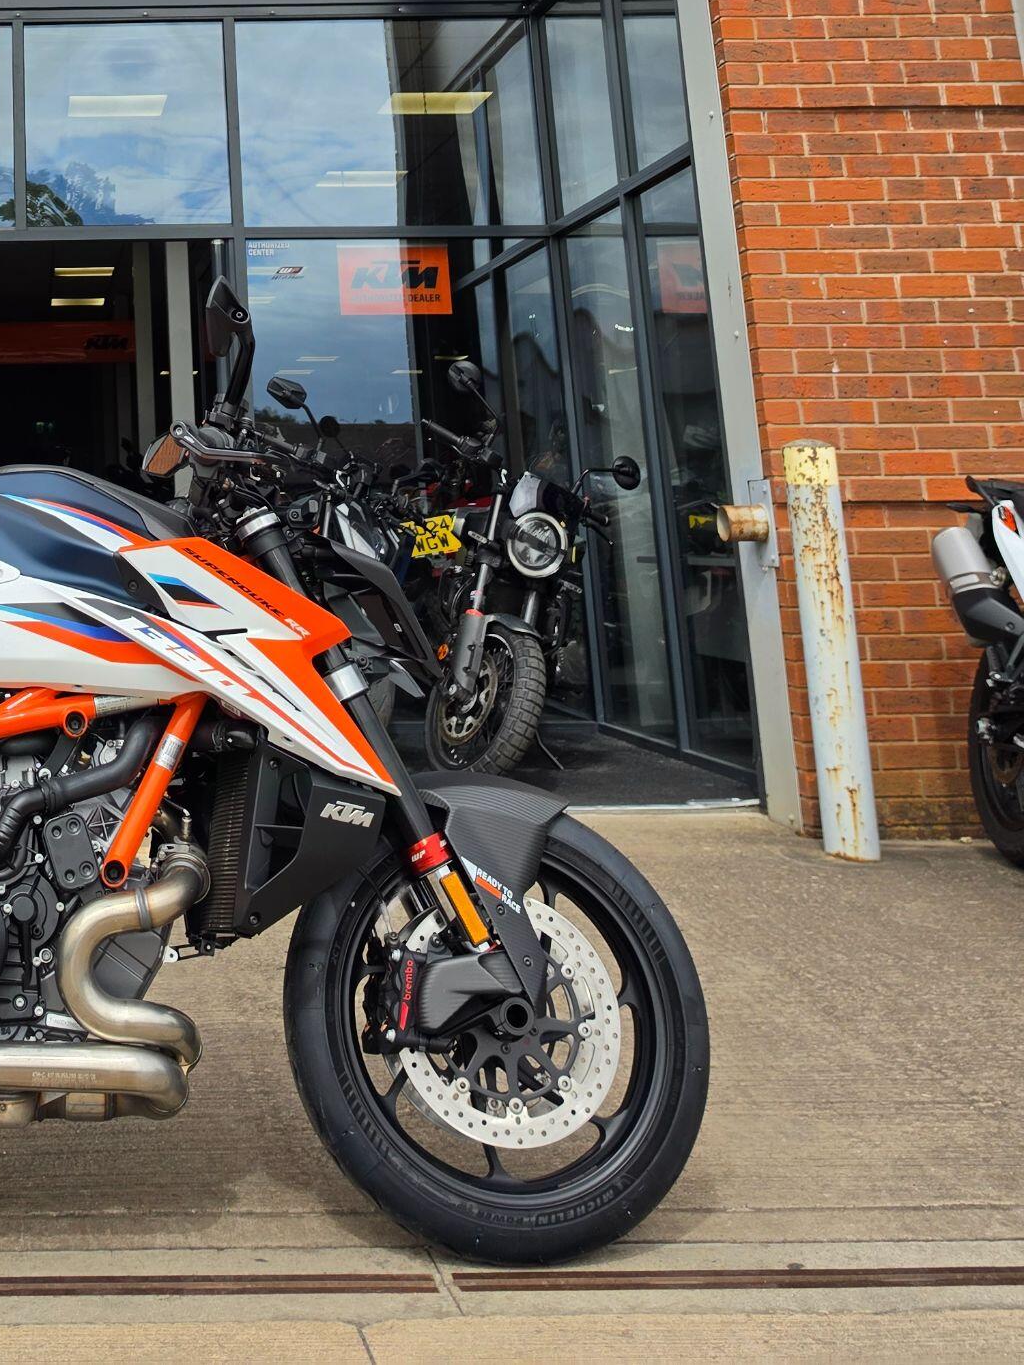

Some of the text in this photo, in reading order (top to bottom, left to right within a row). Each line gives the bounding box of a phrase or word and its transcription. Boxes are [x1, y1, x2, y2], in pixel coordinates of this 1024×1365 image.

[248, 248, 275, 257] CENTER
[351, 260, 439, 289] KTM
[408, 293, 441, 302] DEALER
[182, 547, 285, 617] SUPERDUKE
[320, 801, 374, 828] KTM
[476, 867, 514, 899] READY TO
[501, 894, 522, 914] RACE
[403, 959, 414, 1001] brembo
